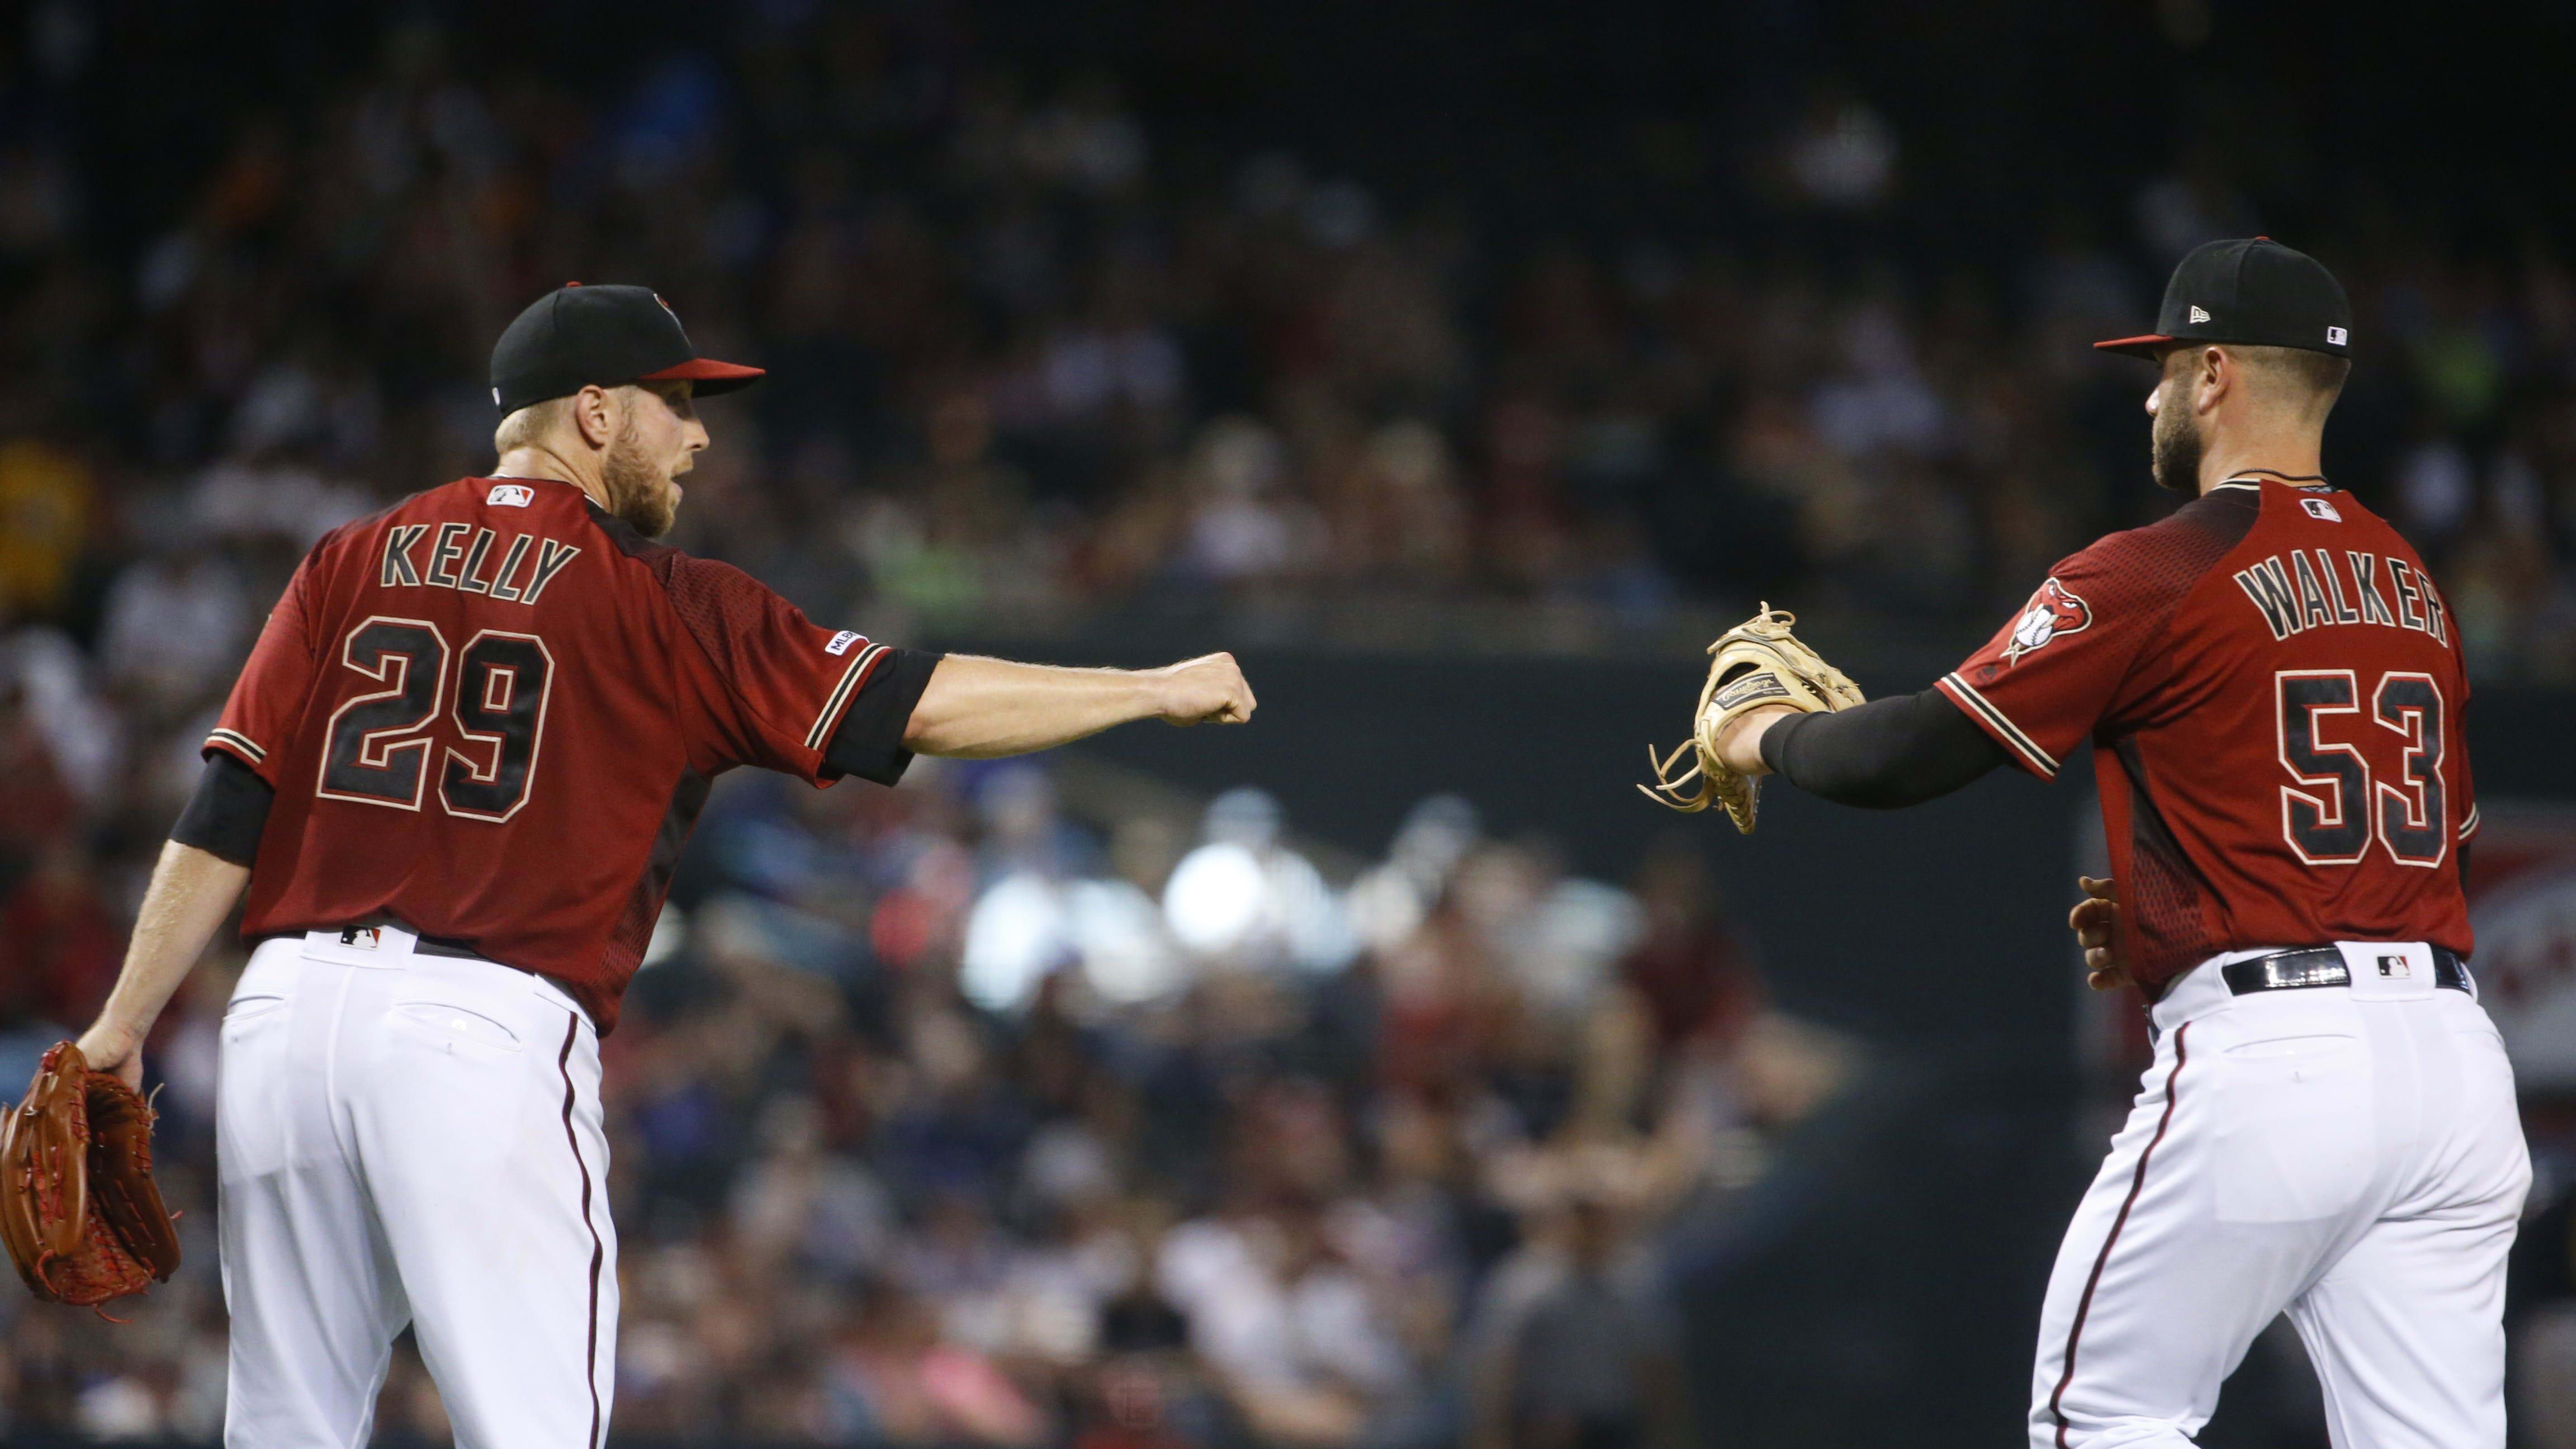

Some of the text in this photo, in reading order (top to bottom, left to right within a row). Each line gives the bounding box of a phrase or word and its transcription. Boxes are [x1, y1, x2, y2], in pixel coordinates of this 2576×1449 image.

[380, 522, 581, 605] KELLY
[2233, 548, 2449, 648] WALKER
[831, 632, 854, 651] MLB
[315, 615, 555, 824] 29
[2275, 669, 2448, 869] 53
